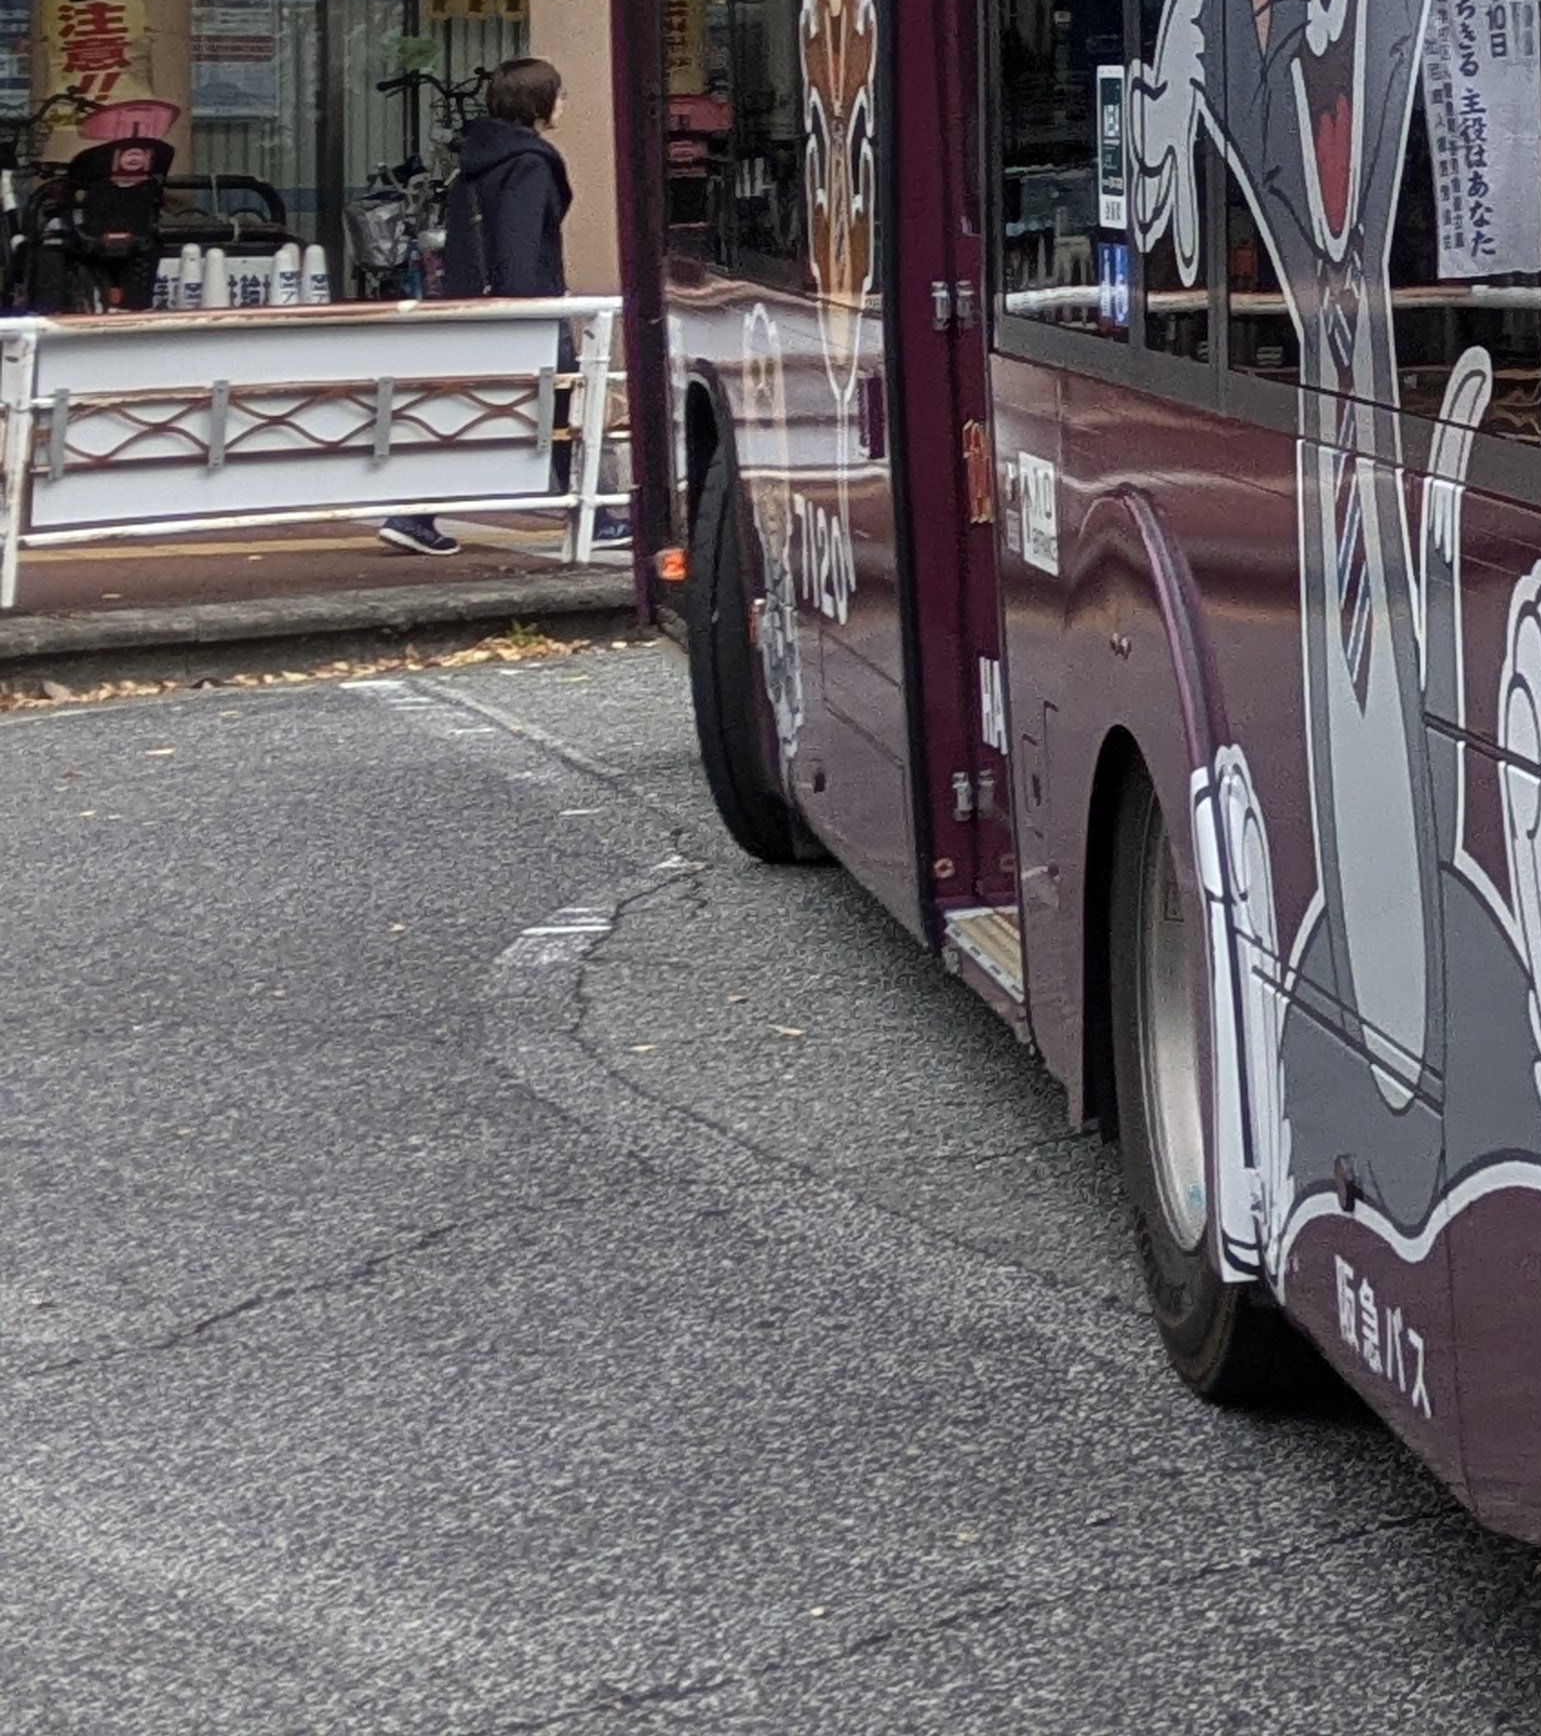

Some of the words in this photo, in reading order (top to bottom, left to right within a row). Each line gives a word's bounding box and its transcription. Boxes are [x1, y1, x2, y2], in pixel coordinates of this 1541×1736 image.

[794, 491, 857, 626] 7120
[1334, 1254, 1432, 1420] 阪急バス
